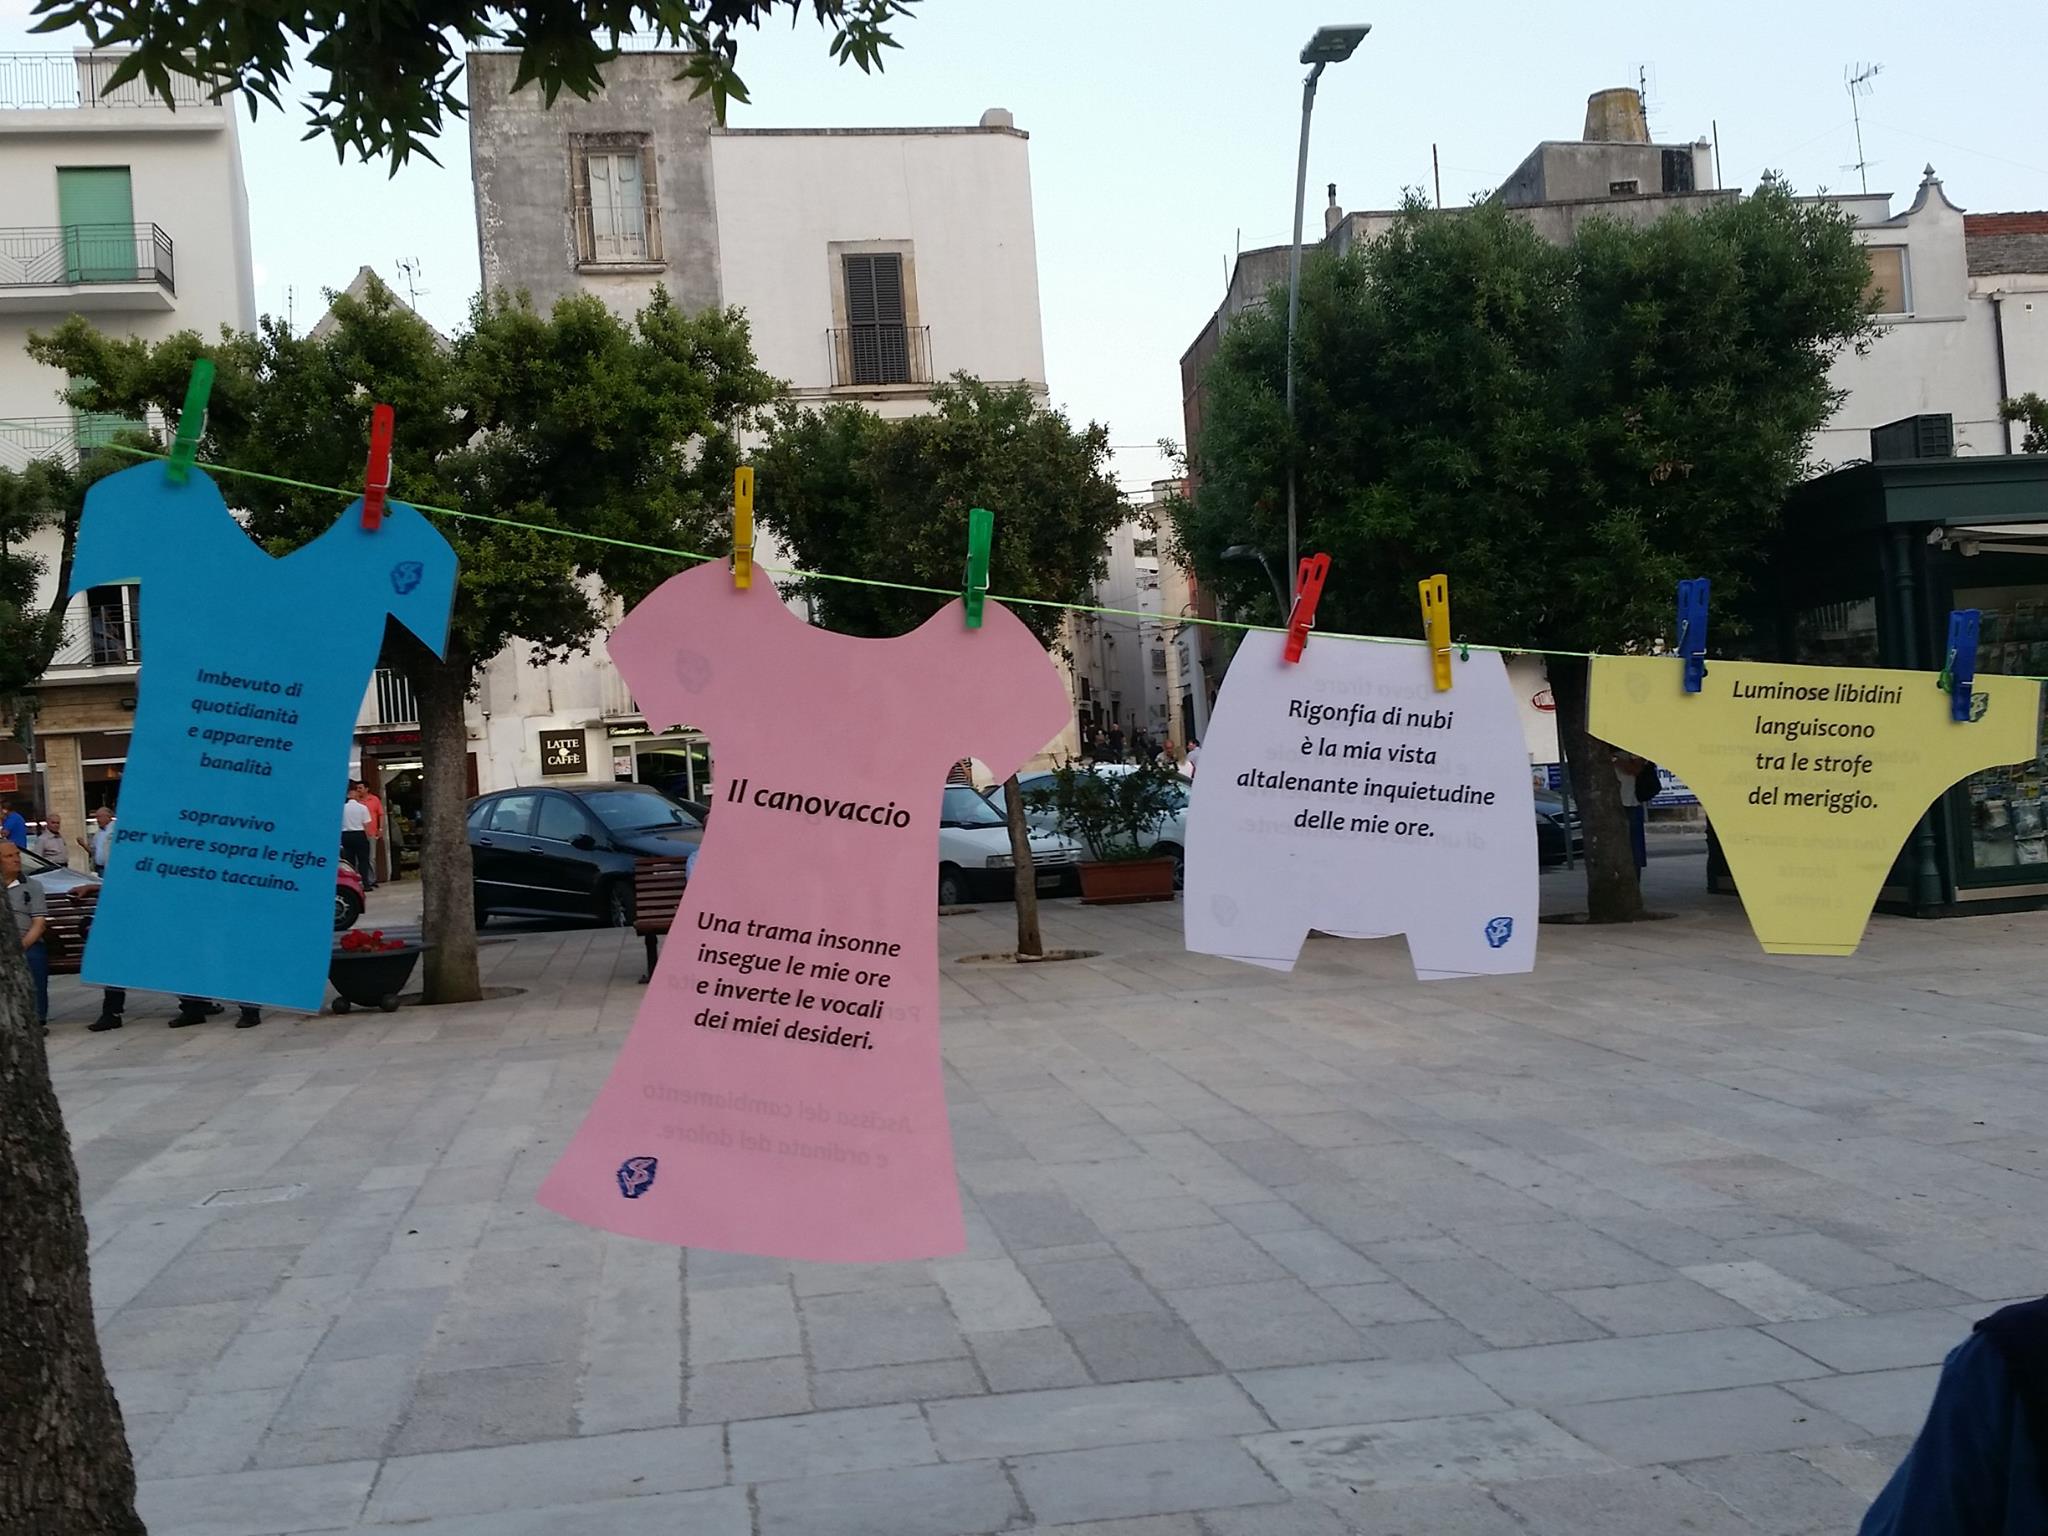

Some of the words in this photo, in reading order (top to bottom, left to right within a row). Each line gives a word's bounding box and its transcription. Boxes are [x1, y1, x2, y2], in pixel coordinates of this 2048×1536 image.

[196, 668, 282, 695] Imbevuto
[284, 682, 303, 698] di
[1732, 680, 1830, 702] Luminose
[1834, 683, 1903, 705] libidini
[191, 698, 299, 725] quotidianità
[1288, 699, 1377, 727] Rigonfia
[1382, 706, 1403, 726] di
[1406, 709, 1454, 730] nubi
[187, 726, 199, 738] e
[201, 728, 294, 752] apparente
[1755, 715, 1876, 742] languiscono
[547, 739, 580, 749] LATTE
[1300, 738, 1314, 756] è
[1318, 737, 1338, 758] la
[1342, 740, 1382, 761] mia
[1388, 743, 1437, 765] vista
[199, 751, 273, 777] banalità
[547, 753, 581, 765] CAFFÈ
[1755, 752, 1786, 770] tra
[1790, 752, 1809, 771] le
[1813, 754, 1873, 778] strofe
[1236, 768, 1359, 795] altalenante
[1363, 777, 1495, 806] inquietudine
[1748, 785, 1779, 806] del
[1783, 789, 1878, 814] meriggio.
[727, 778, 749, 804] Il
[753, 789, 911, 828] canovaccio
[178, 809, 276, 833] sopravvivo
[1294, 808, 1346, 831] delle
[1350, 814, 1390, 834] mie
[1394, 821, 1434, 838] ore.
[115, 829, 149, 844] per
[151, 831, 206, 851] vivere
[207, 841, 259, 859] sopra
[262, 845, 279, 861] le
[281, 849, 327, 870] righe
[135, 856, 155, 873] di
[155, 862, 218, 881] questo
[221, 869, 299, 892] taccuino.
[697, 911, 742, 935] Una
[747, 919, 813, 945] trama
[816, 927, 901, 958] insonne
[697, 943, 782, 975] insegue
[785, 955, 806, 976] le
[809, 961, 850, 982] mie
[854, 970, 891, 988] ore
[696, 980, 710, 995] e
[713, 977, 792, 1006] inverte
[795, 988, 816, 1010] le
[820, 997, 885, 1019] vocali
[694, 1007, 730, 1030] dei
[732, 1015, 781, 1037] miei
[783, 1020, 873, 1050] desideri.
